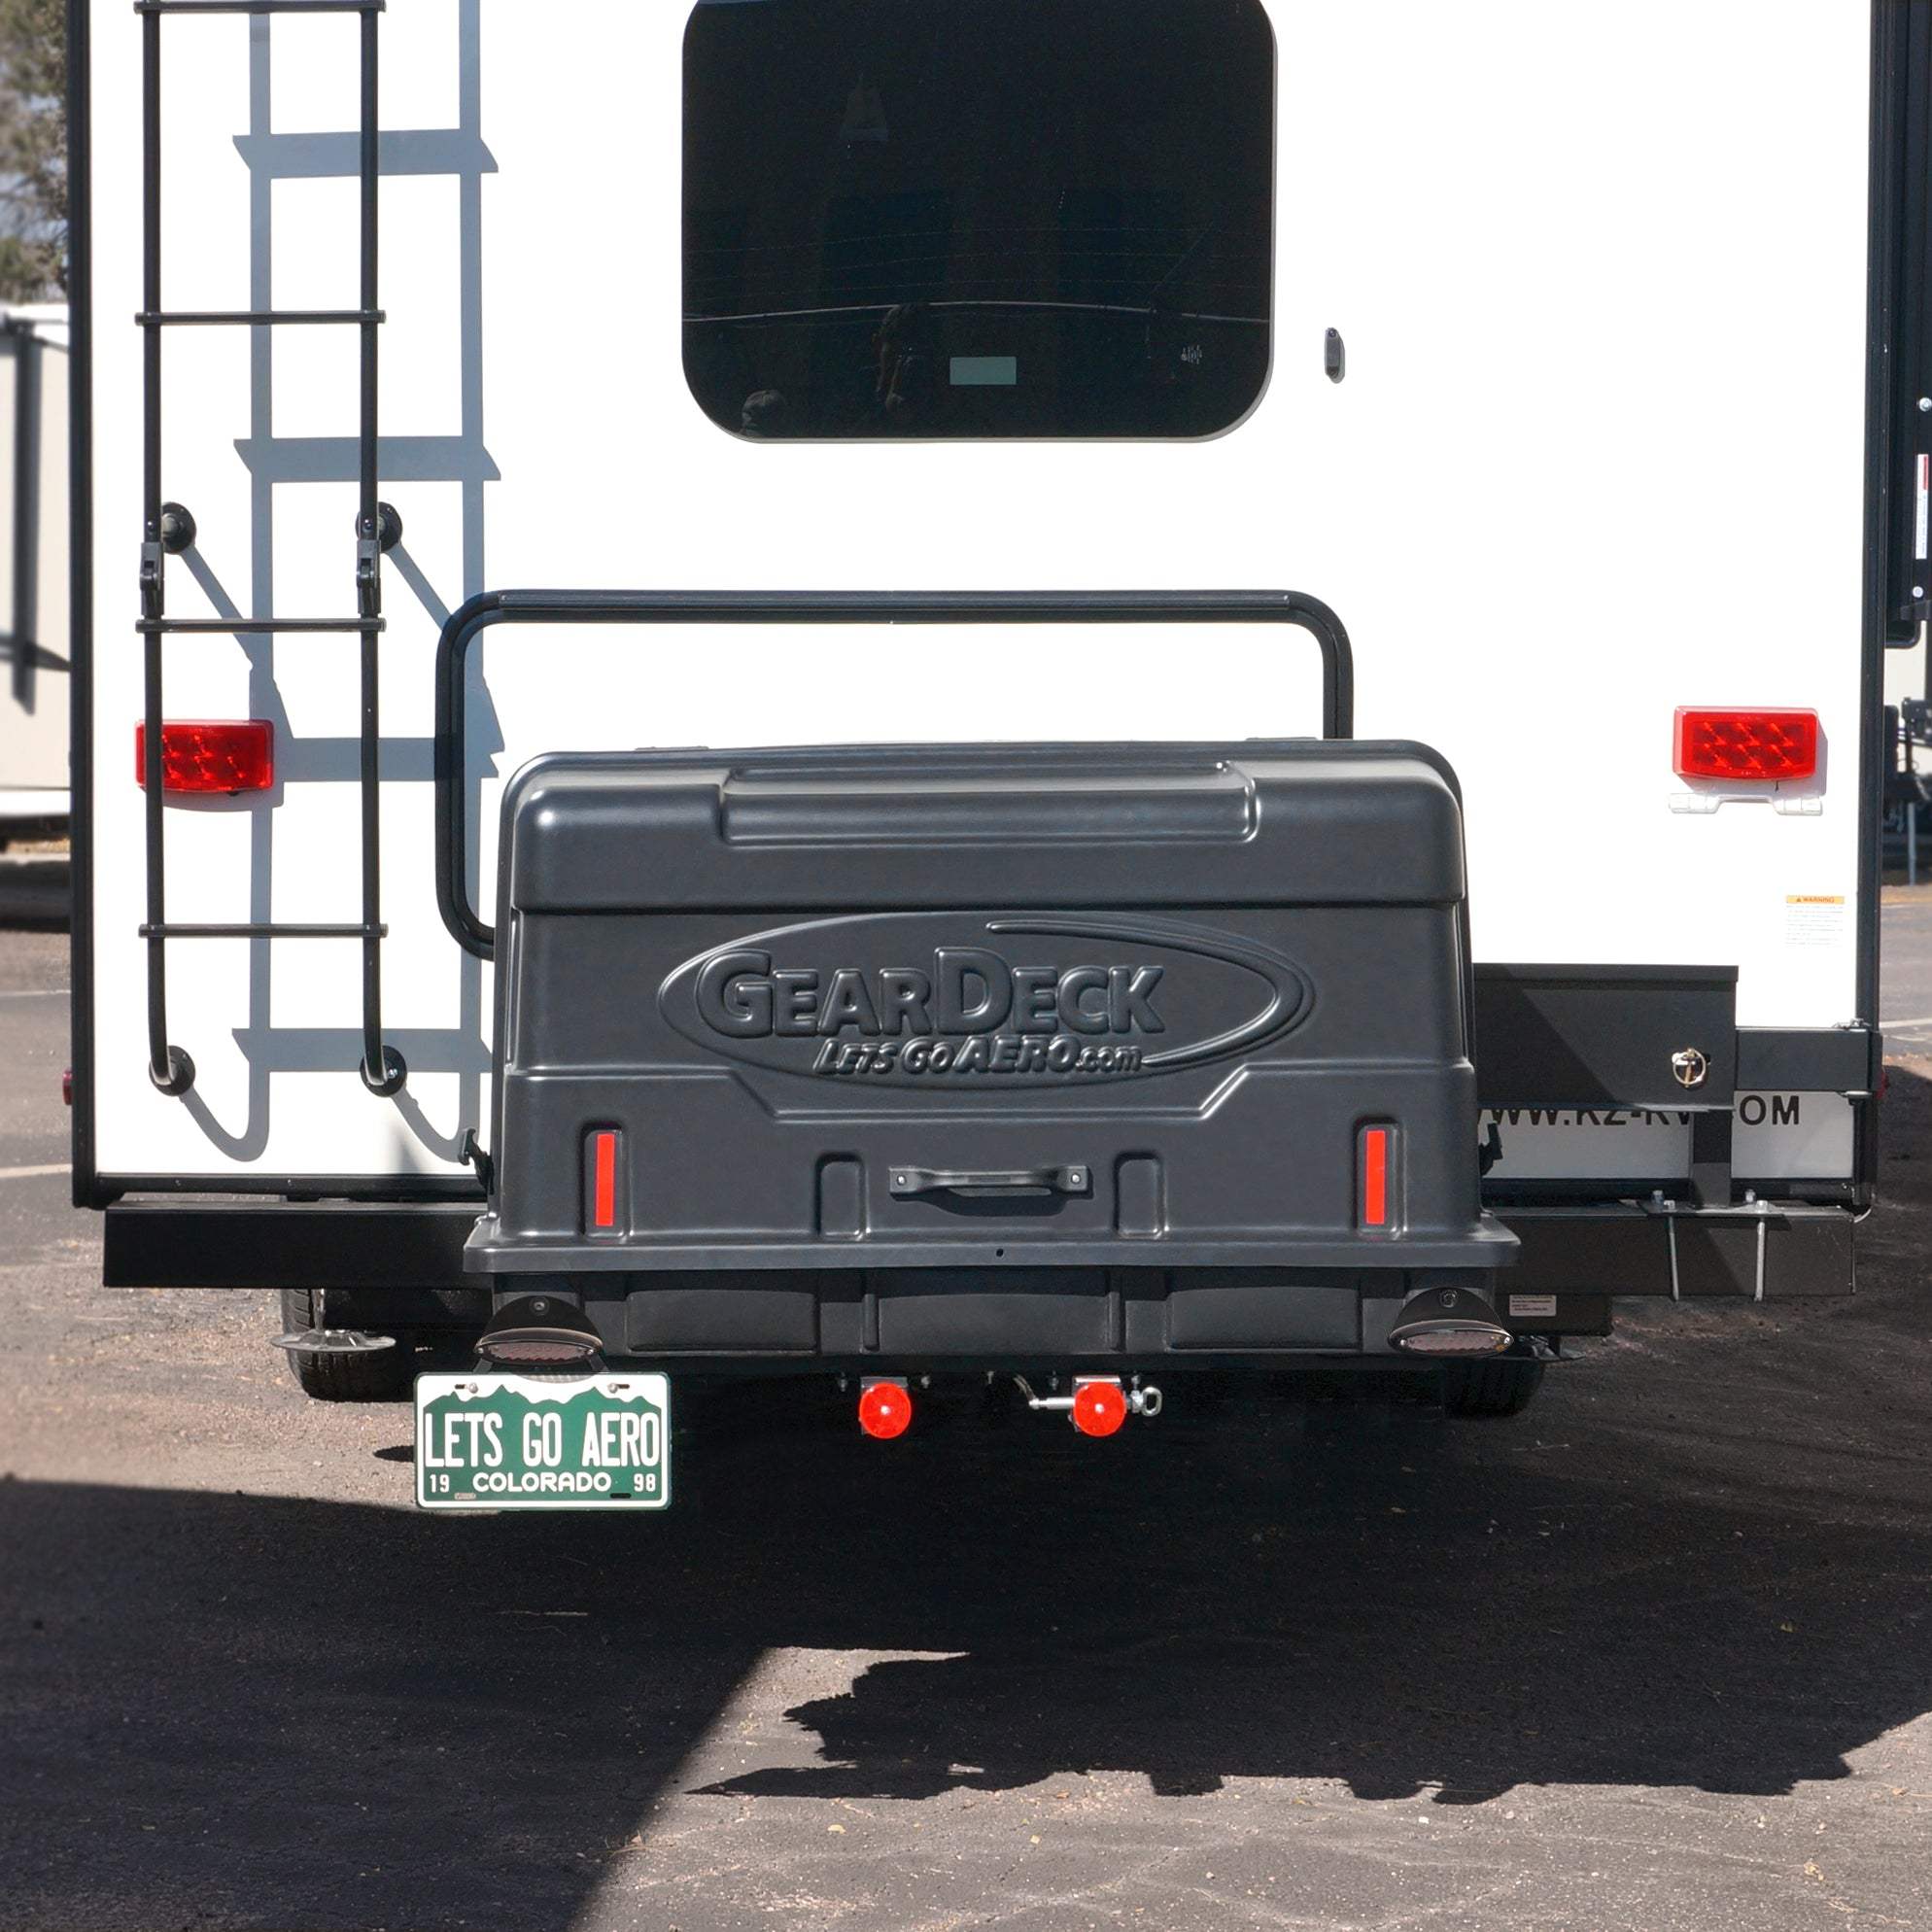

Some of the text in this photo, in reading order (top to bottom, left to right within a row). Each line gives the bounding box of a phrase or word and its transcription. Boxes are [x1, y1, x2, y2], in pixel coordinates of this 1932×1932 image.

[425, 1412, 660, 1467] LETS GO AERO
[429, 1471, 656, 1494] 19 COLORADO 98
